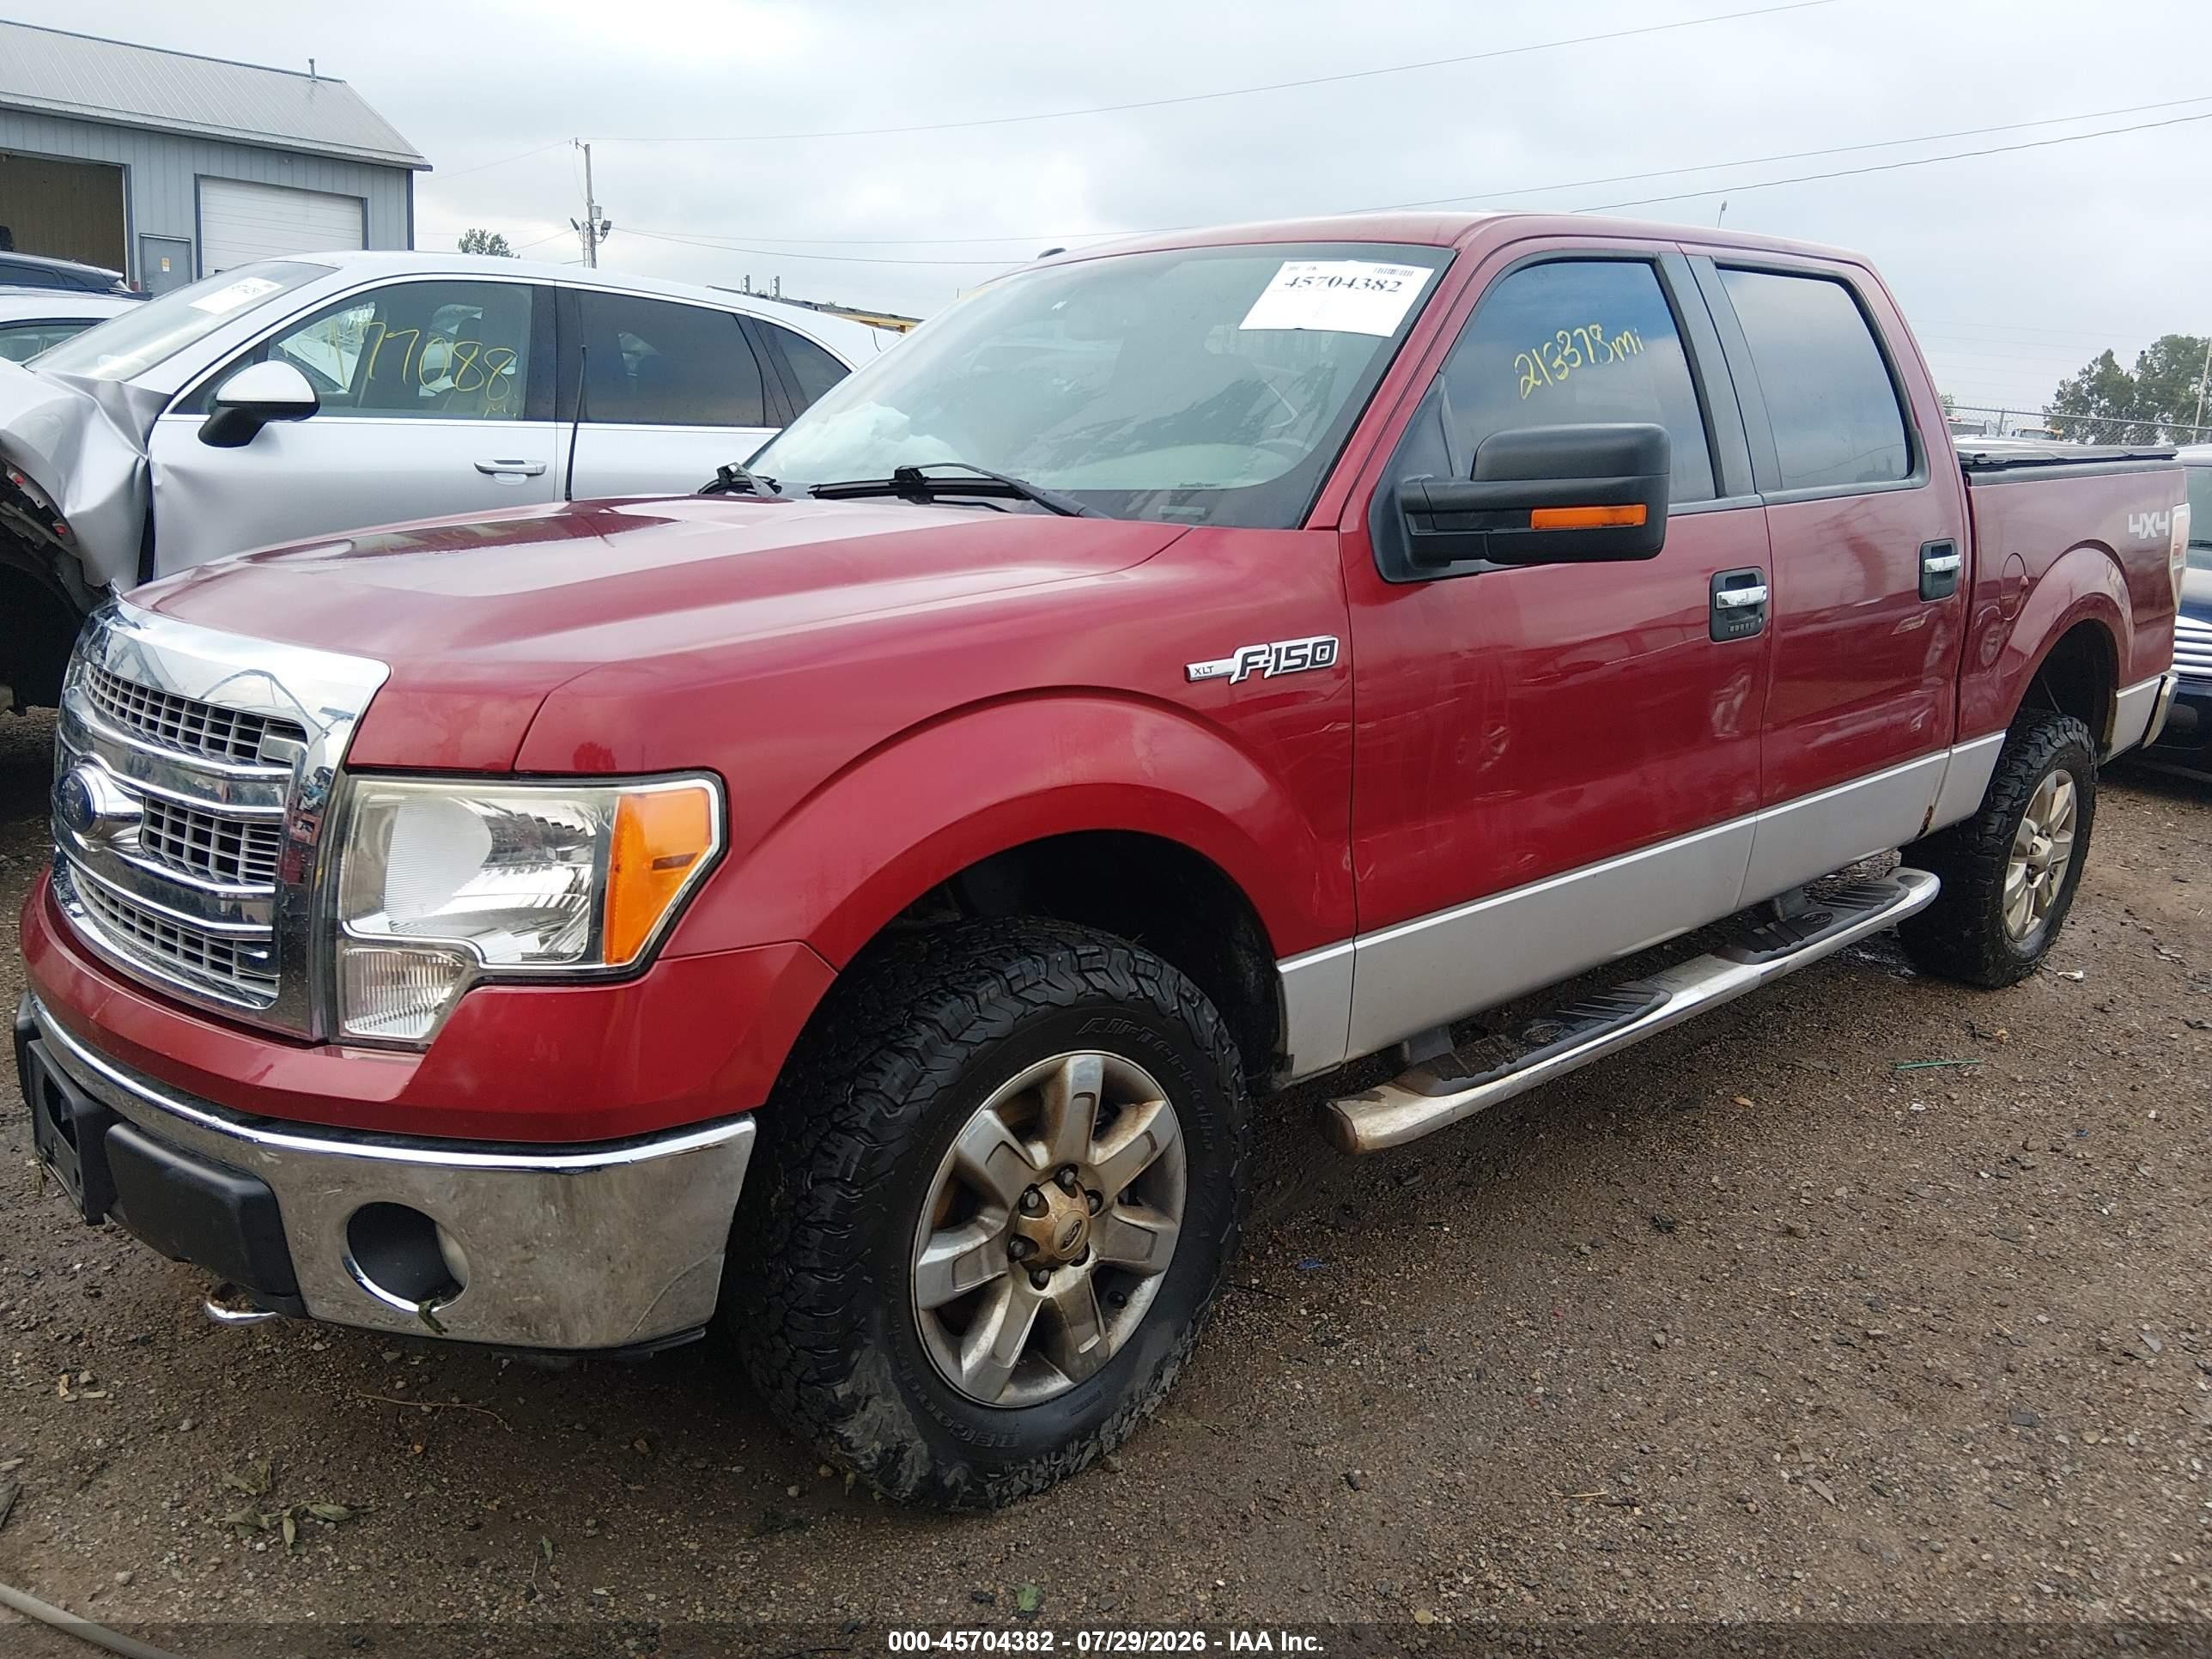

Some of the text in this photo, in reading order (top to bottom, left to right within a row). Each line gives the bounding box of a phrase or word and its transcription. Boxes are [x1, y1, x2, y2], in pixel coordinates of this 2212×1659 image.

[1285, 276, 1402, 293] 45704382
[1194, 635, 1339, 684] XLT F-150
